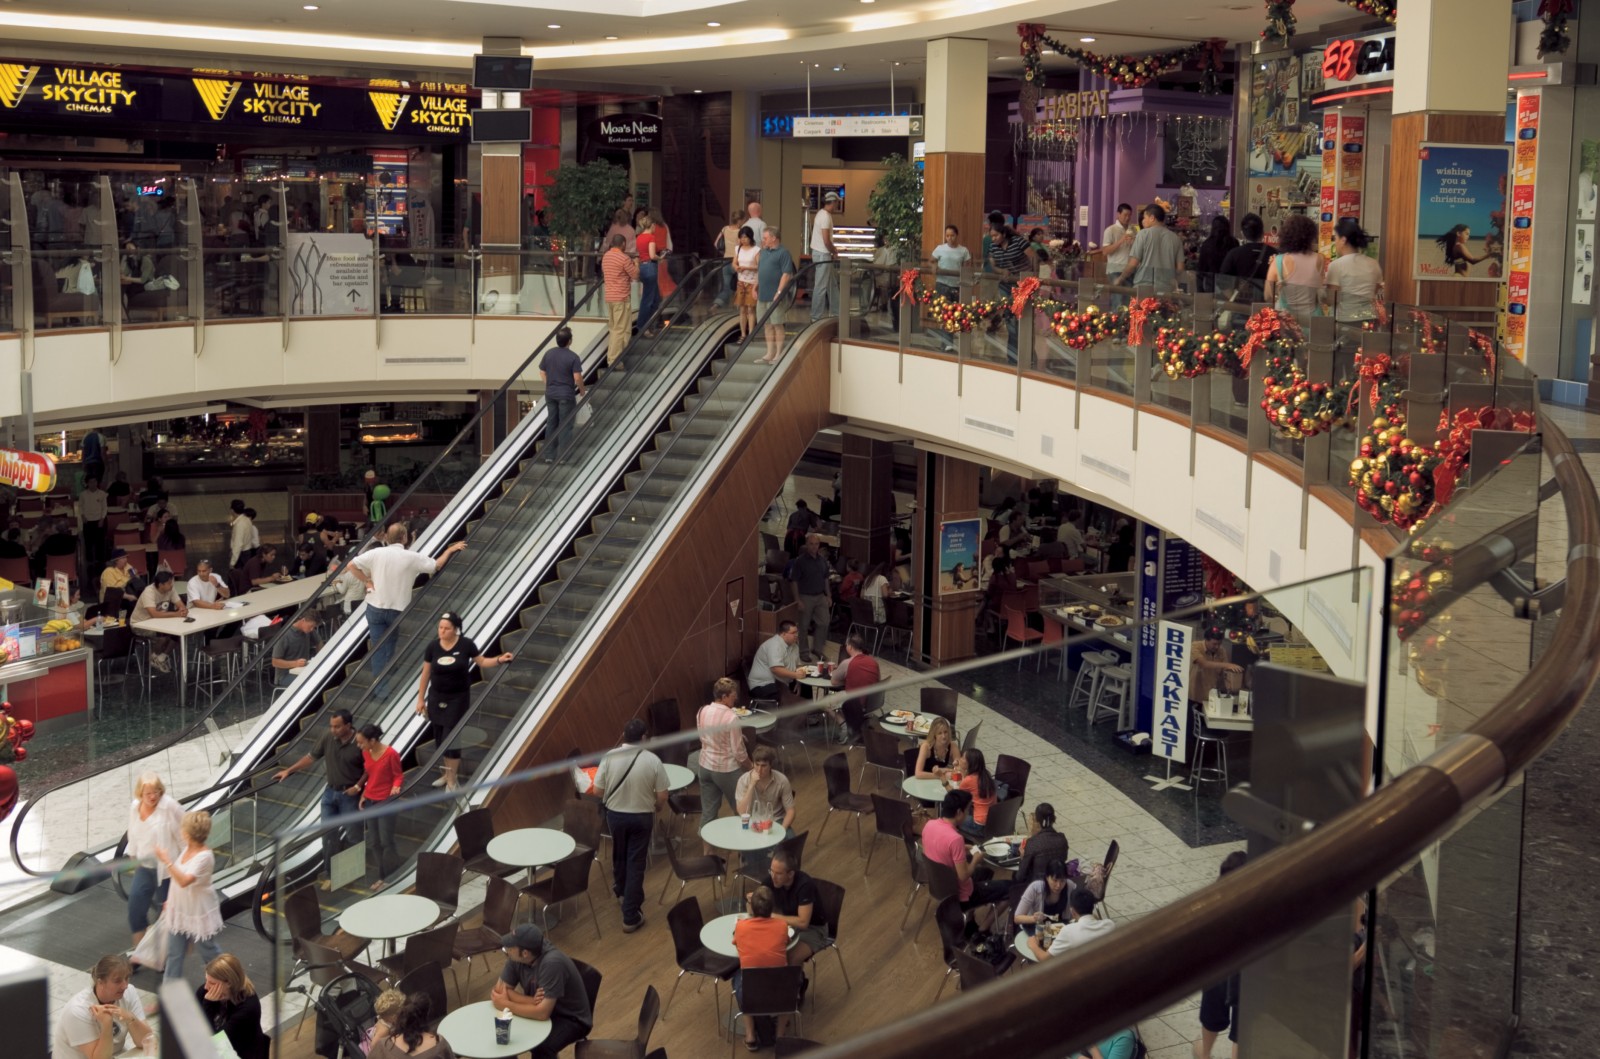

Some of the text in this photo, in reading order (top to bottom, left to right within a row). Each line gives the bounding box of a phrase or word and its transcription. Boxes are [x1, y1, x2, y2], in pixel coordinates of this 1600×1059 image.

[1322, 39, 1357, 81] EB
[54, 67, 122, 89] VILLAGE
[42, 84, 137, 106] SKYCITY
[253, 82, 309, 101] VILLAGE
[65, 103, 112, 114] CINEMAS
[243, 98, 322, 117] SKYCITY
[420, 95, 467, 113] VILLAGE
[1044, 89, 1110, 120] HABITAT
[262, 114, 301, 124] CINEMAS
[912, 120, 920, 131] 2
[426, 125, 460, 134] CINEMAS
[600, 121, 658, 135] Moa's Nest
[1436, 168, 1473, 177] wishing
[1441, 178, 1458, 186] you
[1440, 187, 1467, 195] merry
[1430, 195, 1476, 204] christmas
[0, 452, 35, 490] hippy
[1160, 627, 1185, 758] BREAKFAST
